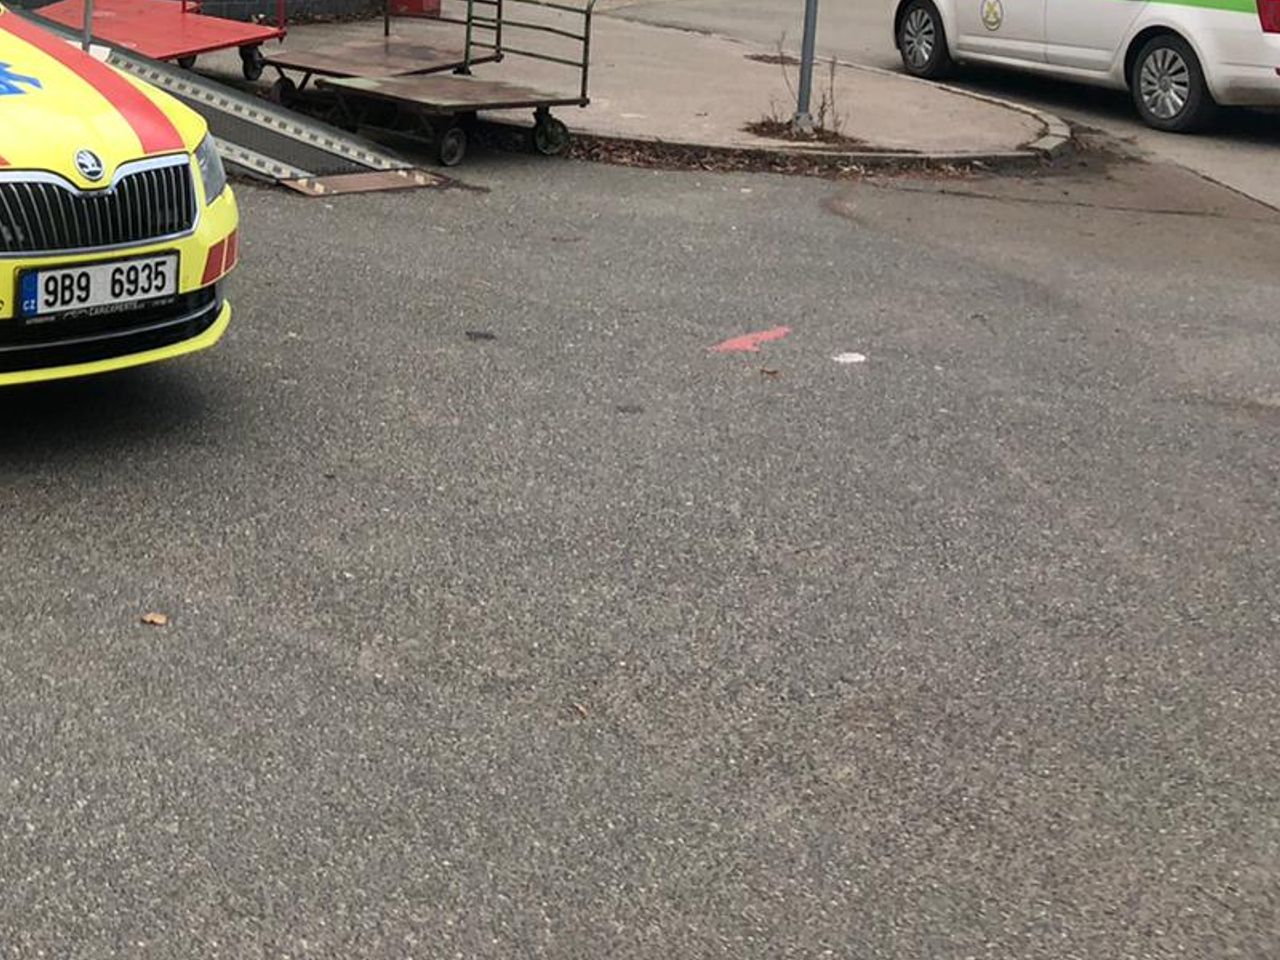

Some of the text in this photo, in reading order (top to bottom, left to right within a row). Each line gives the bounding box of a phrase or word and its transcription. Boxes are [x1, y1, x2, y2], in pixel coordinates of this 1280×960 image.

[44, 260, 167, 308] 9B9 6935
[22, 298, 36, 311] CZ
